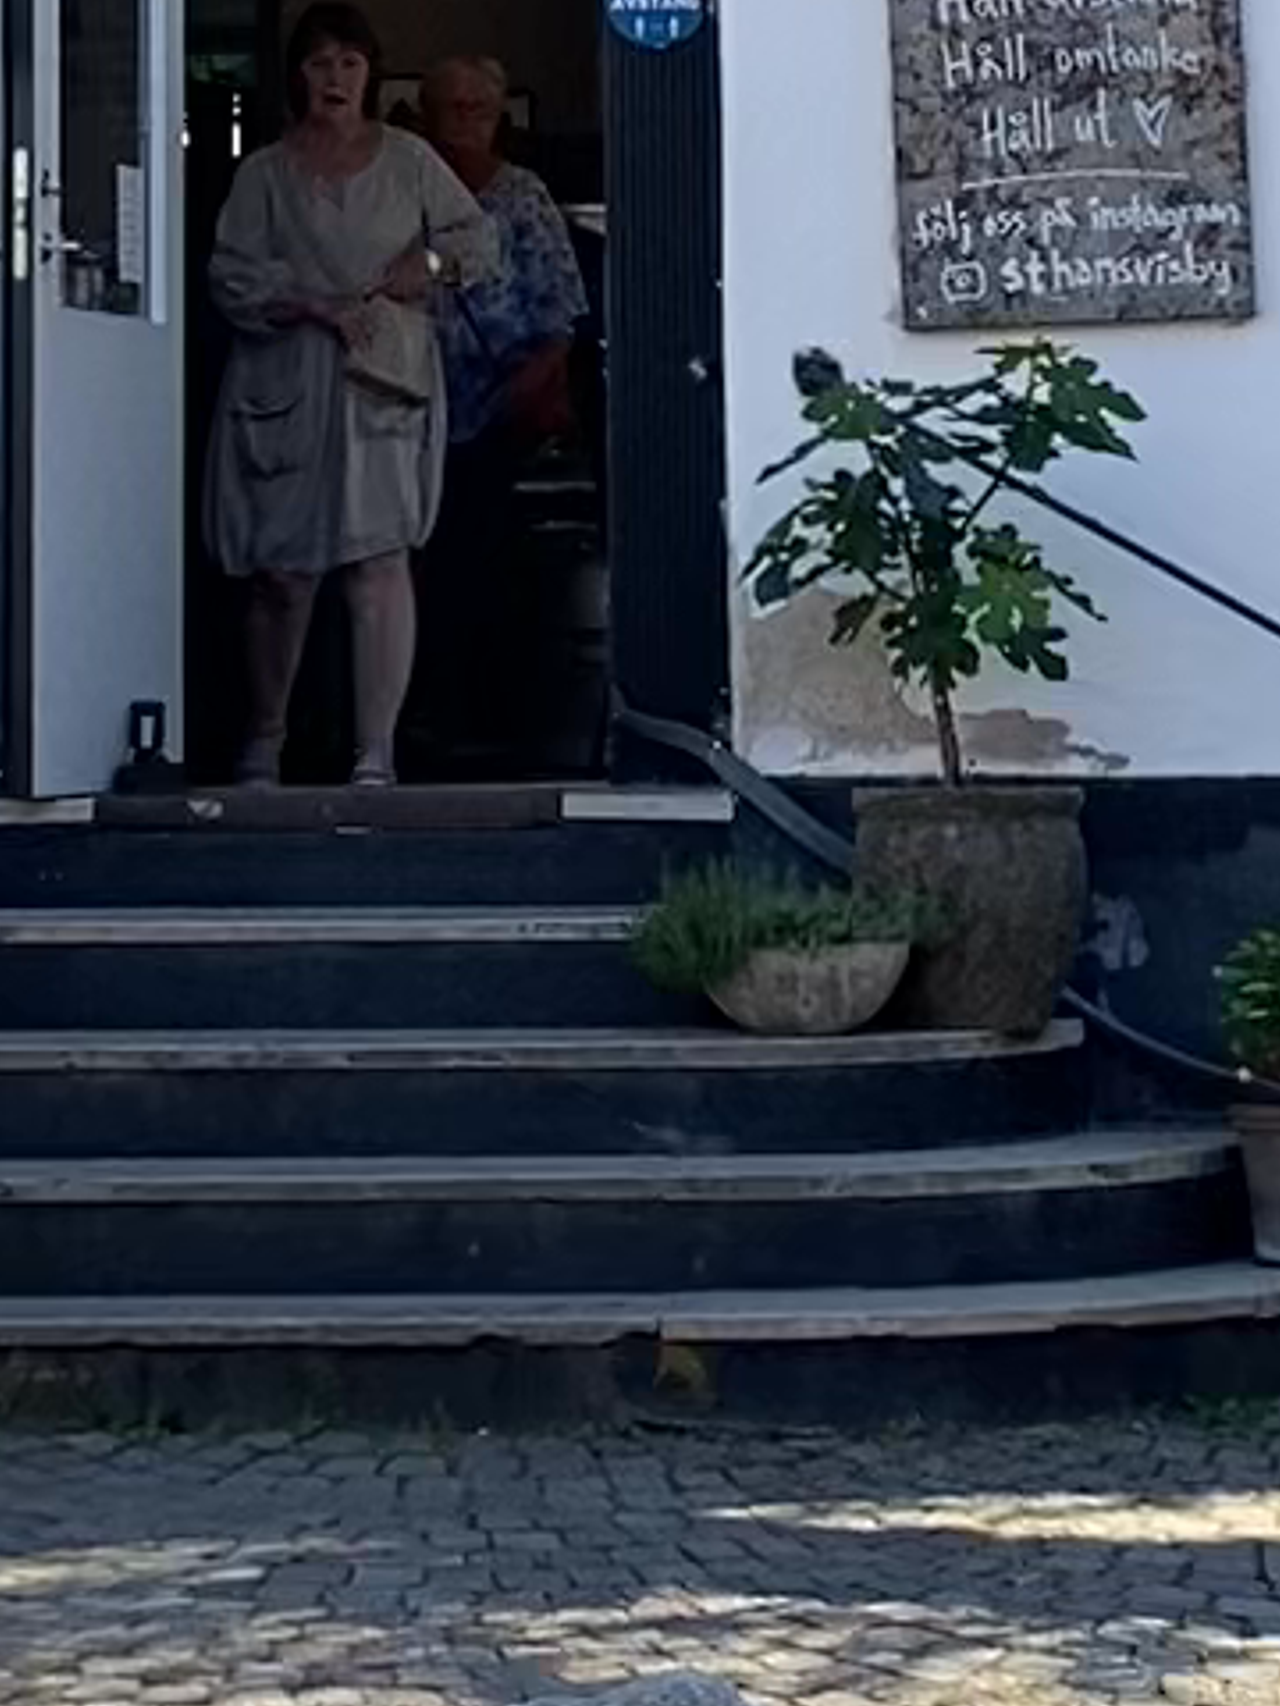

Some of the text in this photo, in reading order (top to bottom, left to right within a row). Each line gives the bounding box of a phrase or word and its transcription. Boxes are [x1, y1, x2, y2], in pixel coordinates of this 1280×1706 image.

[942, 34, 1026, 88] Håll
[981, 89, 1117, 159] Håll ut
